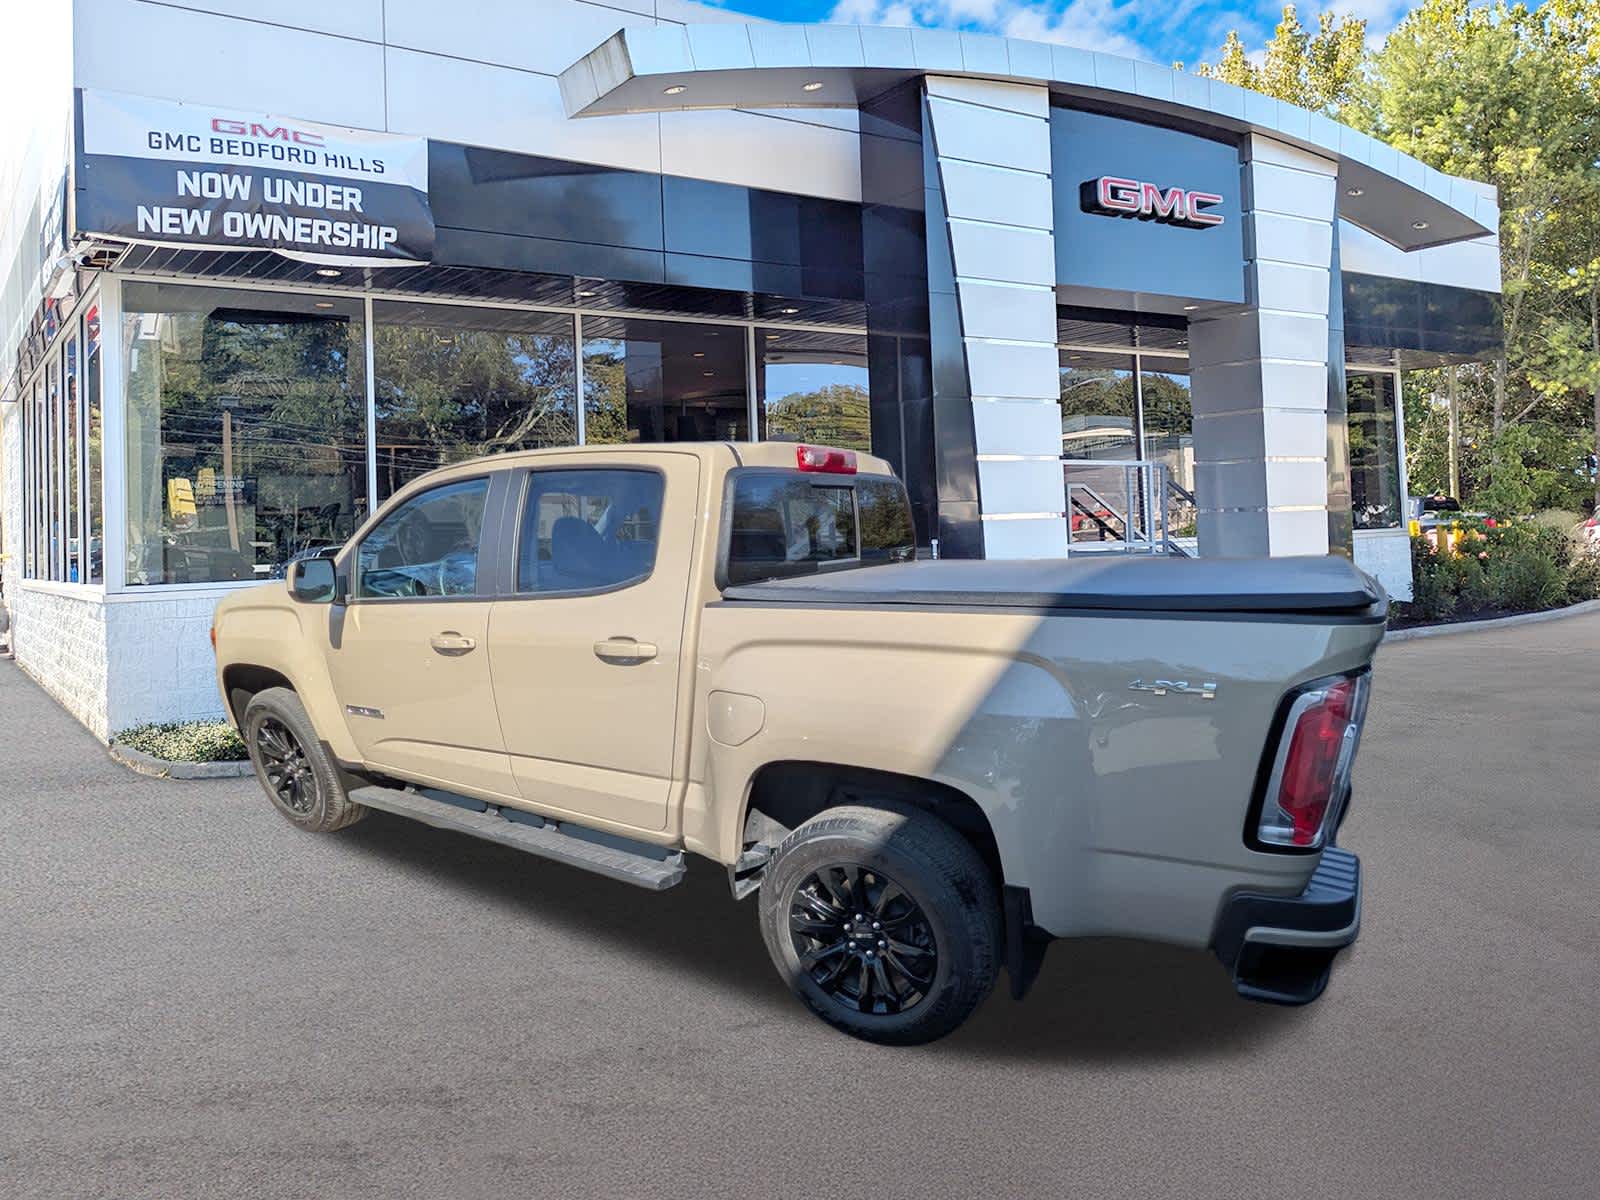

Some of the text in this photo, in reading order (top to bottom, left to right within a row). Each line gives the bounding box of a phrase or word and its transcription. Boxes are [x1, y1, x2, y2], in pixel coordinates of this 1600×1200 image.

[148, 131, 386, 175] GMC BEDFORD HILLS
[211, 118, 326, 148] GMC
[176, 169, 364, 213] NOW UNDER
[1096, 175, 1225, 226] GMC
[137, 205, 398, 250] NEW OWNERSHIP
